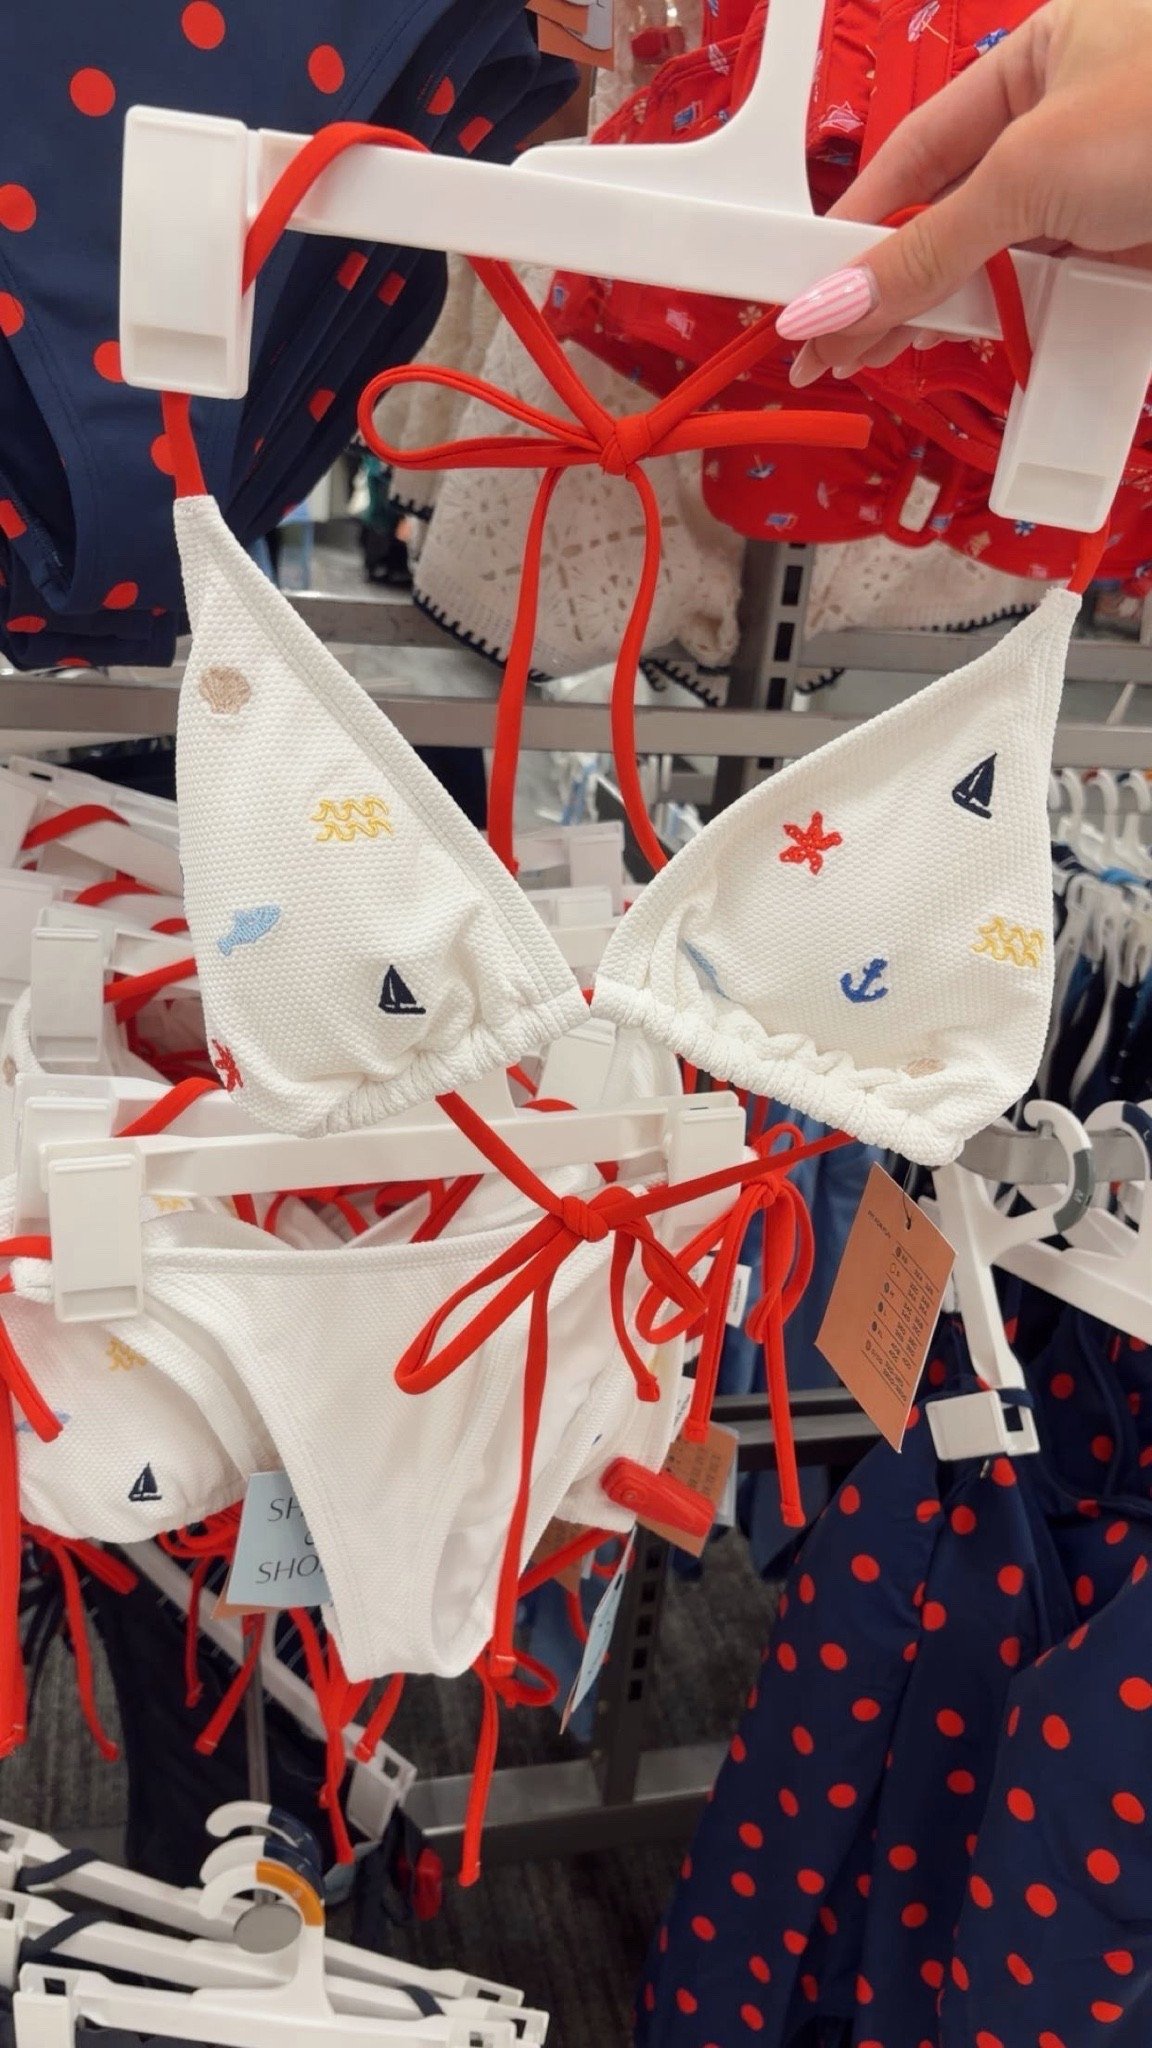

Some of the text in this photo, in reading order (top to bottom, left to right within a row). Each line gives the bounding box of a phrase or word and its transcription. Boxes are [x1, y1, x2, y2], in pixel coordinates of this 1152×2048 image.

[1072, 1190, 1084, 1203] M
[267, 1497, 304, 1522] SH
[255, 1554, 324, 1584] SHO
